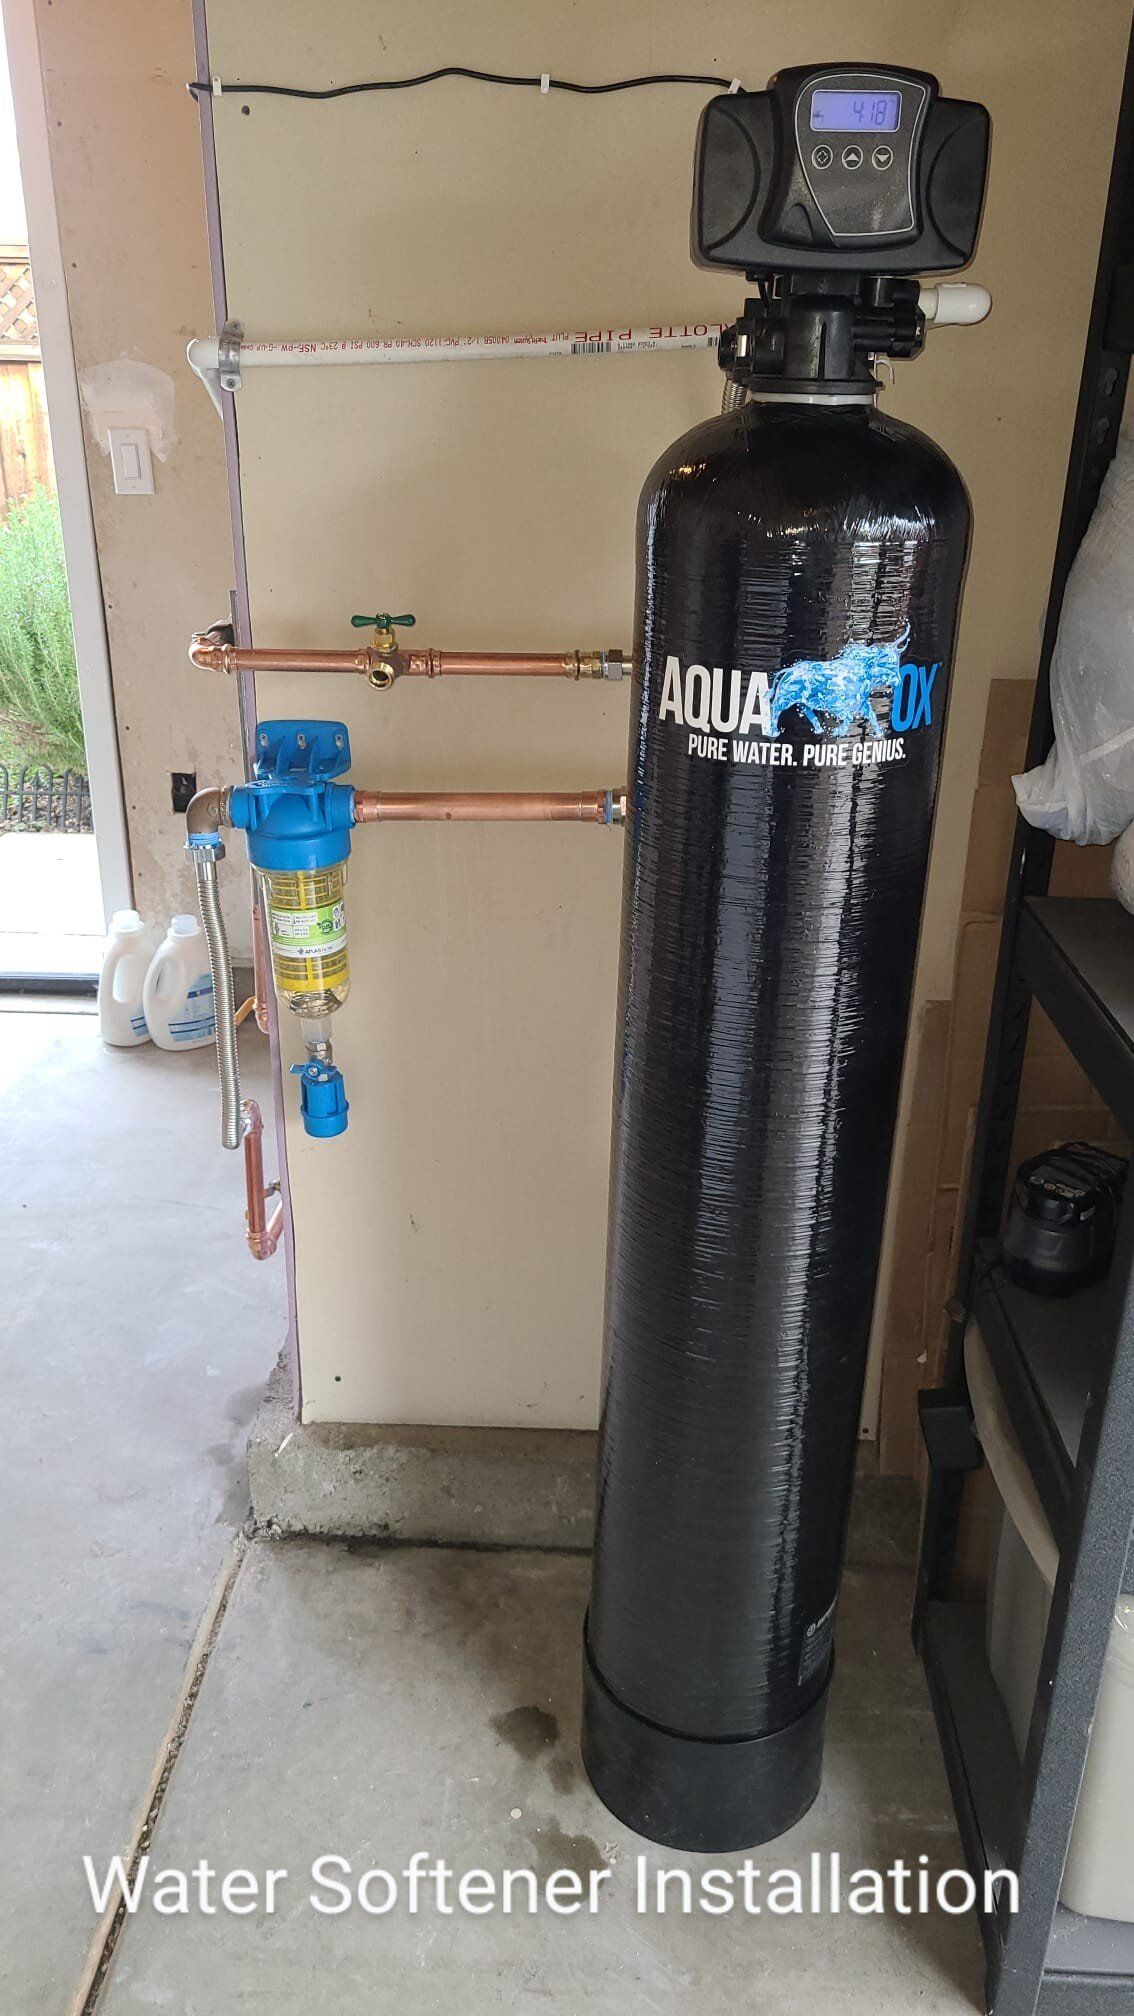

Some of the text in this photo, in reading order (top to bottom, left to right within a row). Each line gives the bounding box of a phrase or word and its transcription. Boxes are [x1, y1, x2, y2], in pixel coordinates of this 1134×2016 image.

[351, 341, 363, 350] PSI
[575, 329, 632, 343] PIPE
[659, 655, 943, 735] AQUA OX
[688, 733, 906, 767] PURE WATER. PURE GENIUS.
